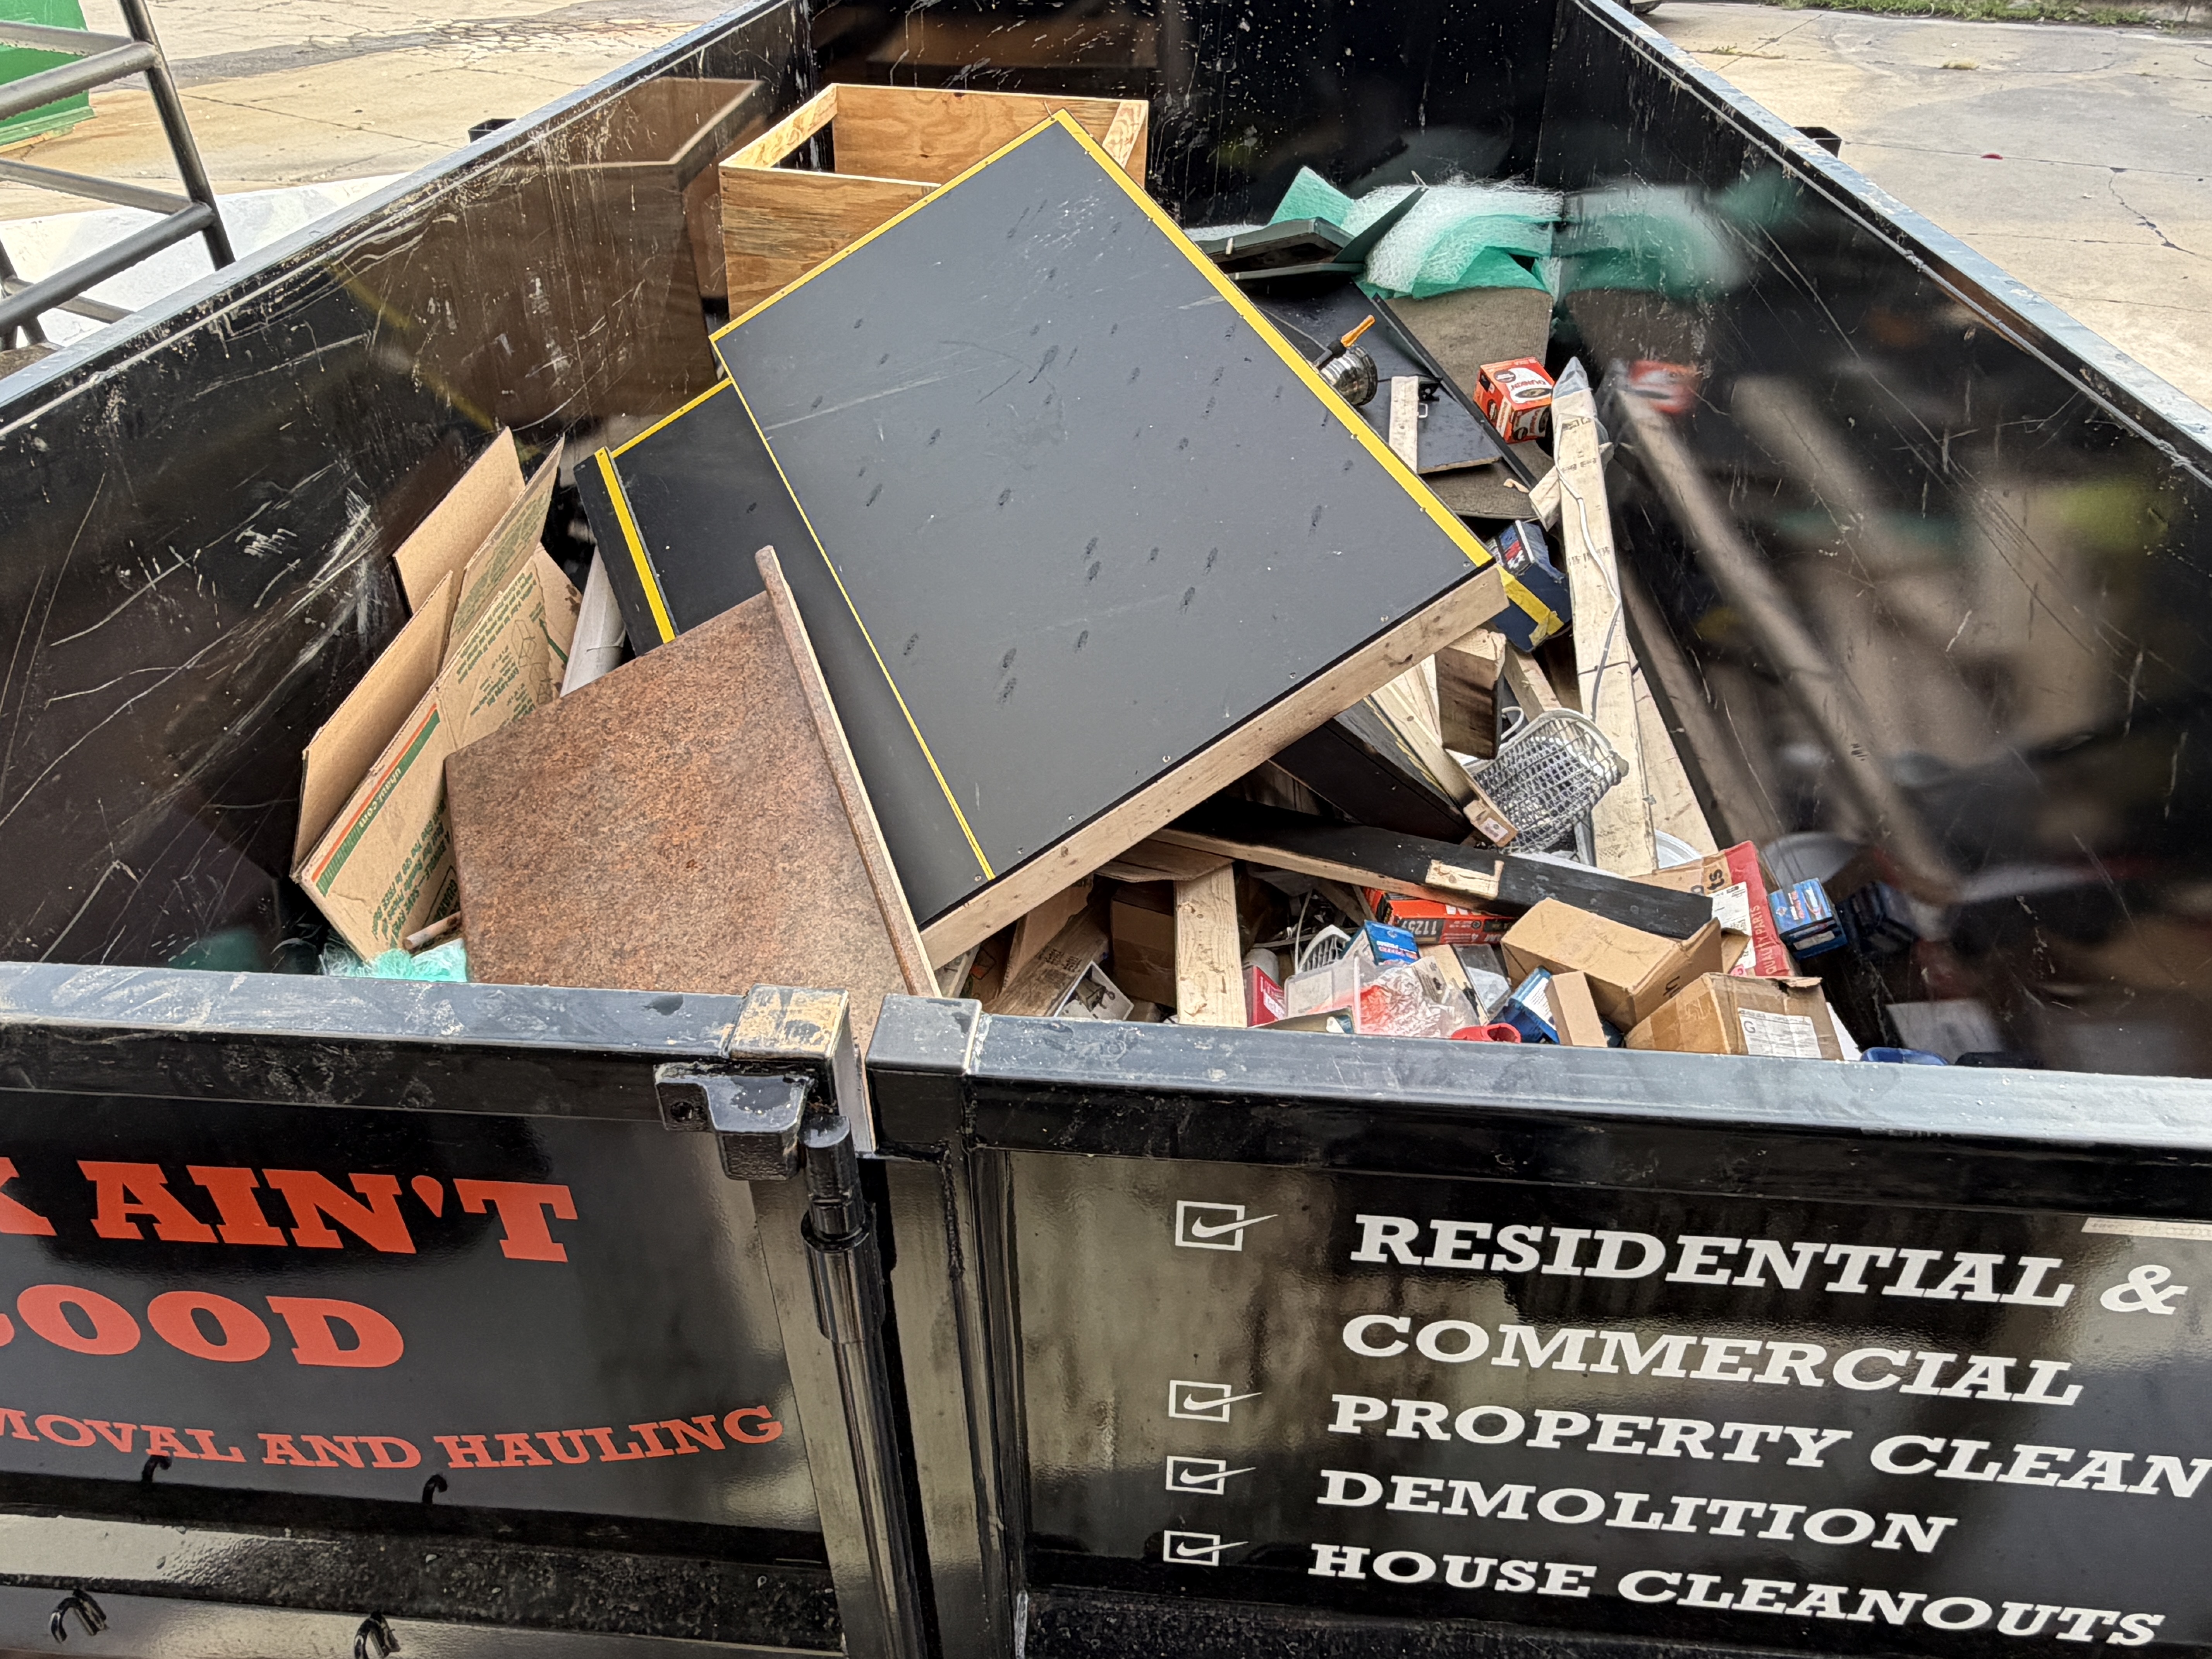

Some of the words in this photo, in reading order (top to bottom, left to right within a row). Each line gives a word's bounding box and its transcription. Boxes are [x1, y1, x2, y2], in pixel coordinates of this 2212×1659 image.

[359, 767, 402, 828] uhaul.com
[1750, 905, 1767, 936] PARTS
[1755, 936, 1778, 975] QUALITY
[1743, 1020, 1756, 1033] G
[78, 1161, 577, 1262] AIN'T
[1351, 1214, 2075, 1307] RESIDENTIAL
[2100, 1264, 2190, 1316] &
[0, 1285, 404, 1368] OOD
[1343, 1314, 2084, 1406] COMMERCIAL
[258, 1434, 421, 1468] AND
[434, 1406, 783, 1468] HAULING
[1328, 1394, 1853, 1468] PROPERTY
[1870, 1435, 2212, 1498] CLEAN
[1317, 1469, 1957, 1552] DEMOLITION
[1308, 1544, 1597, 1597] HOUSE
[1618, 1570, 2166, 1646] CLEANOUTS
